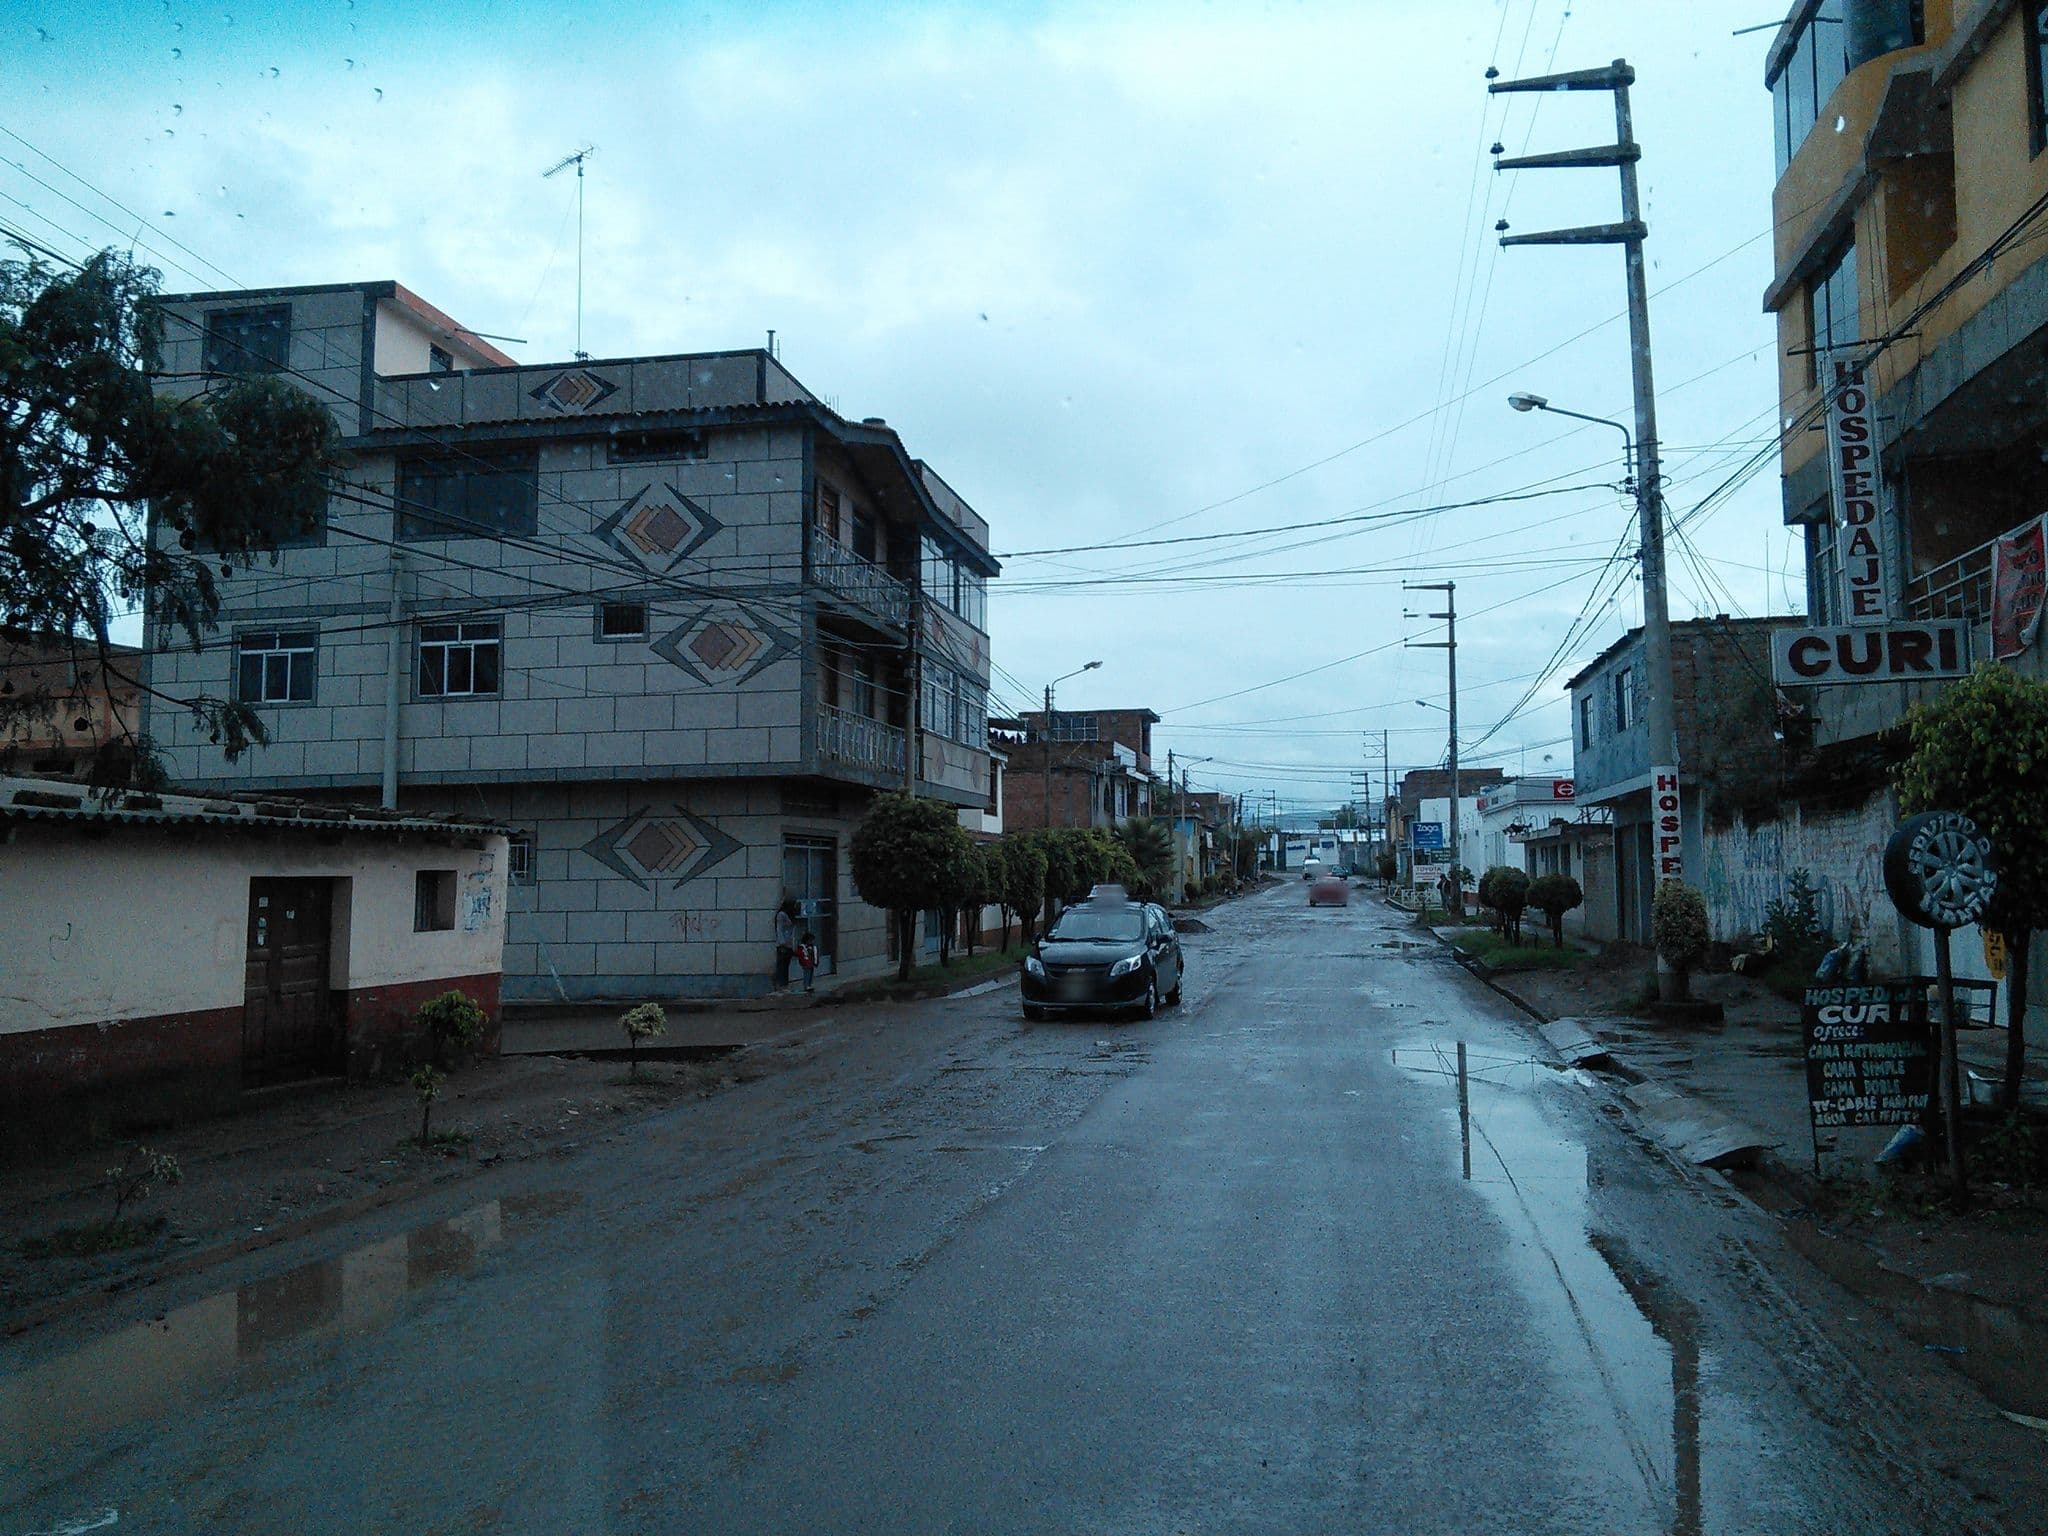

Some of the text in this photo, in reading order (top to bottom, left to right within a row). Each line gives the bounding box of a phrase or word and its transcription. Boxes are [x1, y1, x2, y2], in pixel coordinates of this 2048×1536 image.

[1835, 360, 1882, 617] HOSPEDAJE
[1788, 628, 1958, 677] CURI
[1656, 774, 1682, 884] HOSPE
[1823, 1060, 1857, 1078] CAMA
[1823, 1080, 1856, 1096] CAMA
